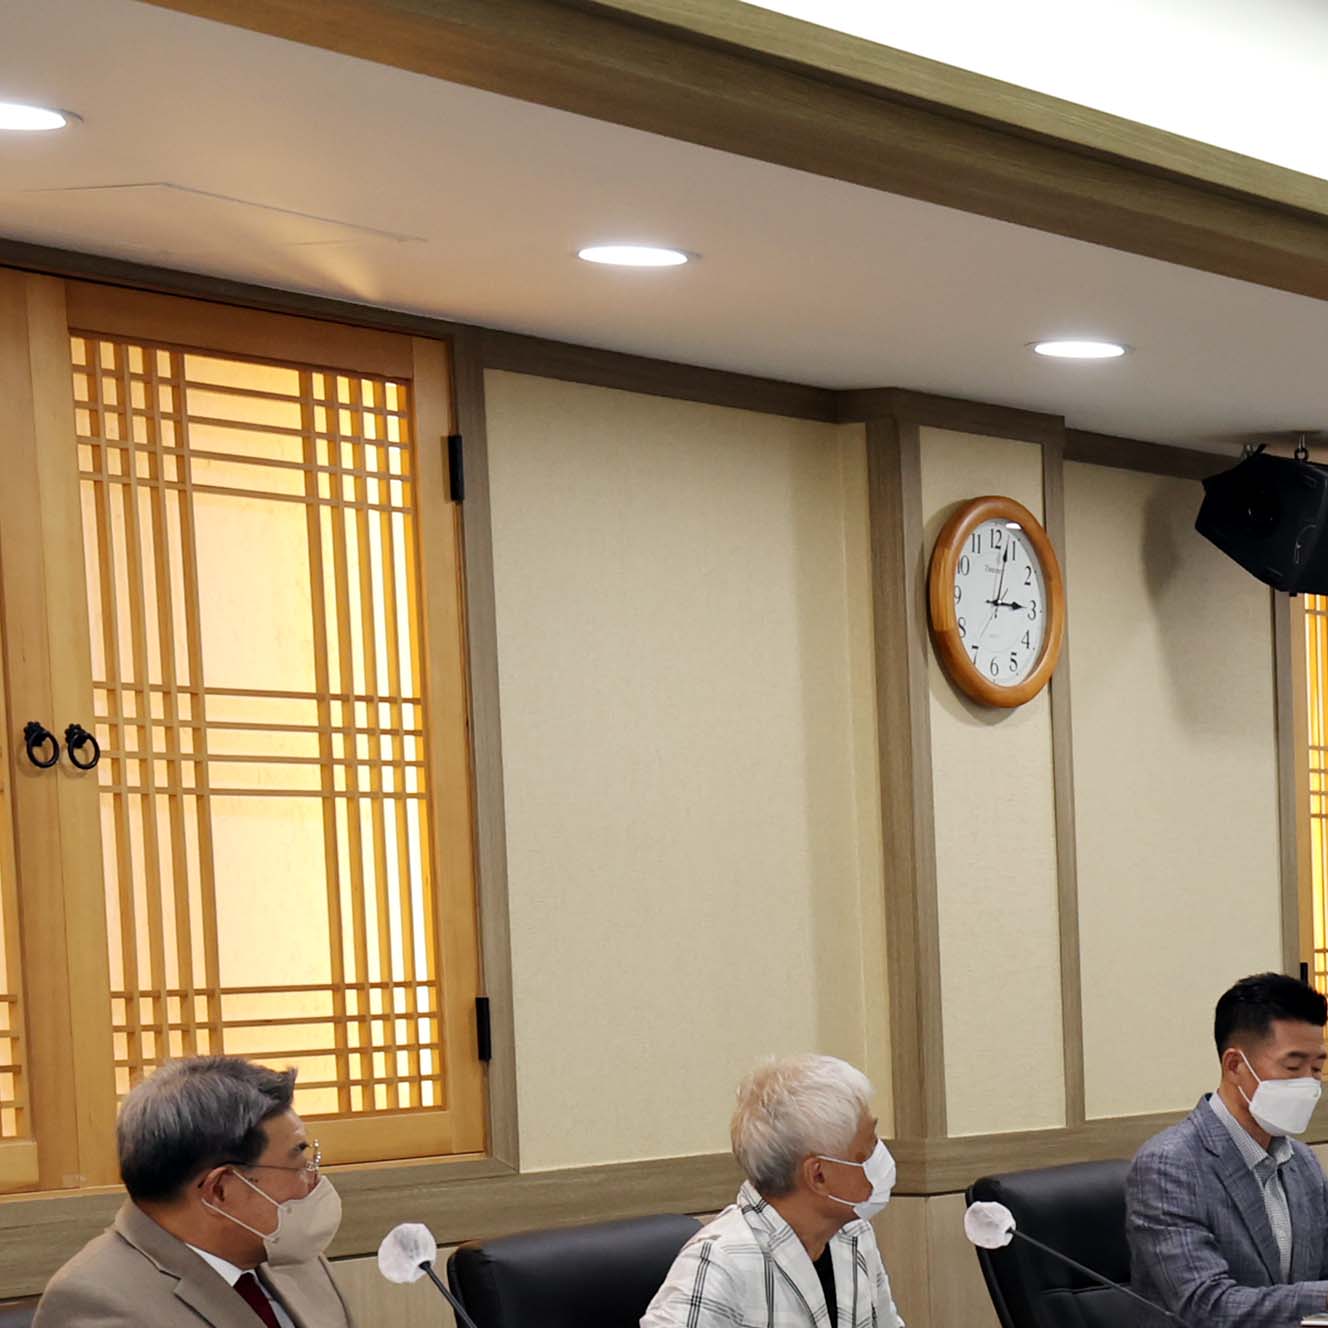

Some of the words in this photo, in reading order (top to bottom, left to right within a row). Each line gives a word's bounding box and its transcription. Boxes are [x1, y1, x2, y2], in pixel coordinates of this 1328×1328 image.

[971, 533, 981, 553] 11
[990, 528, 1002, 549] 12
[1012, 540, 1017, 561] 1
[1024, 566, 1033, 585] 2
[955, 585, 961, 605] 9
[1027, 600, 1037, 621] 3
[958, 617, 967, 638] 8
[1021, 630, 1030, 649] 4
[971, 645, 979, 665] 7
[1009, 652, 1018, 672] 5
[990, 656, 999, 676] 6
